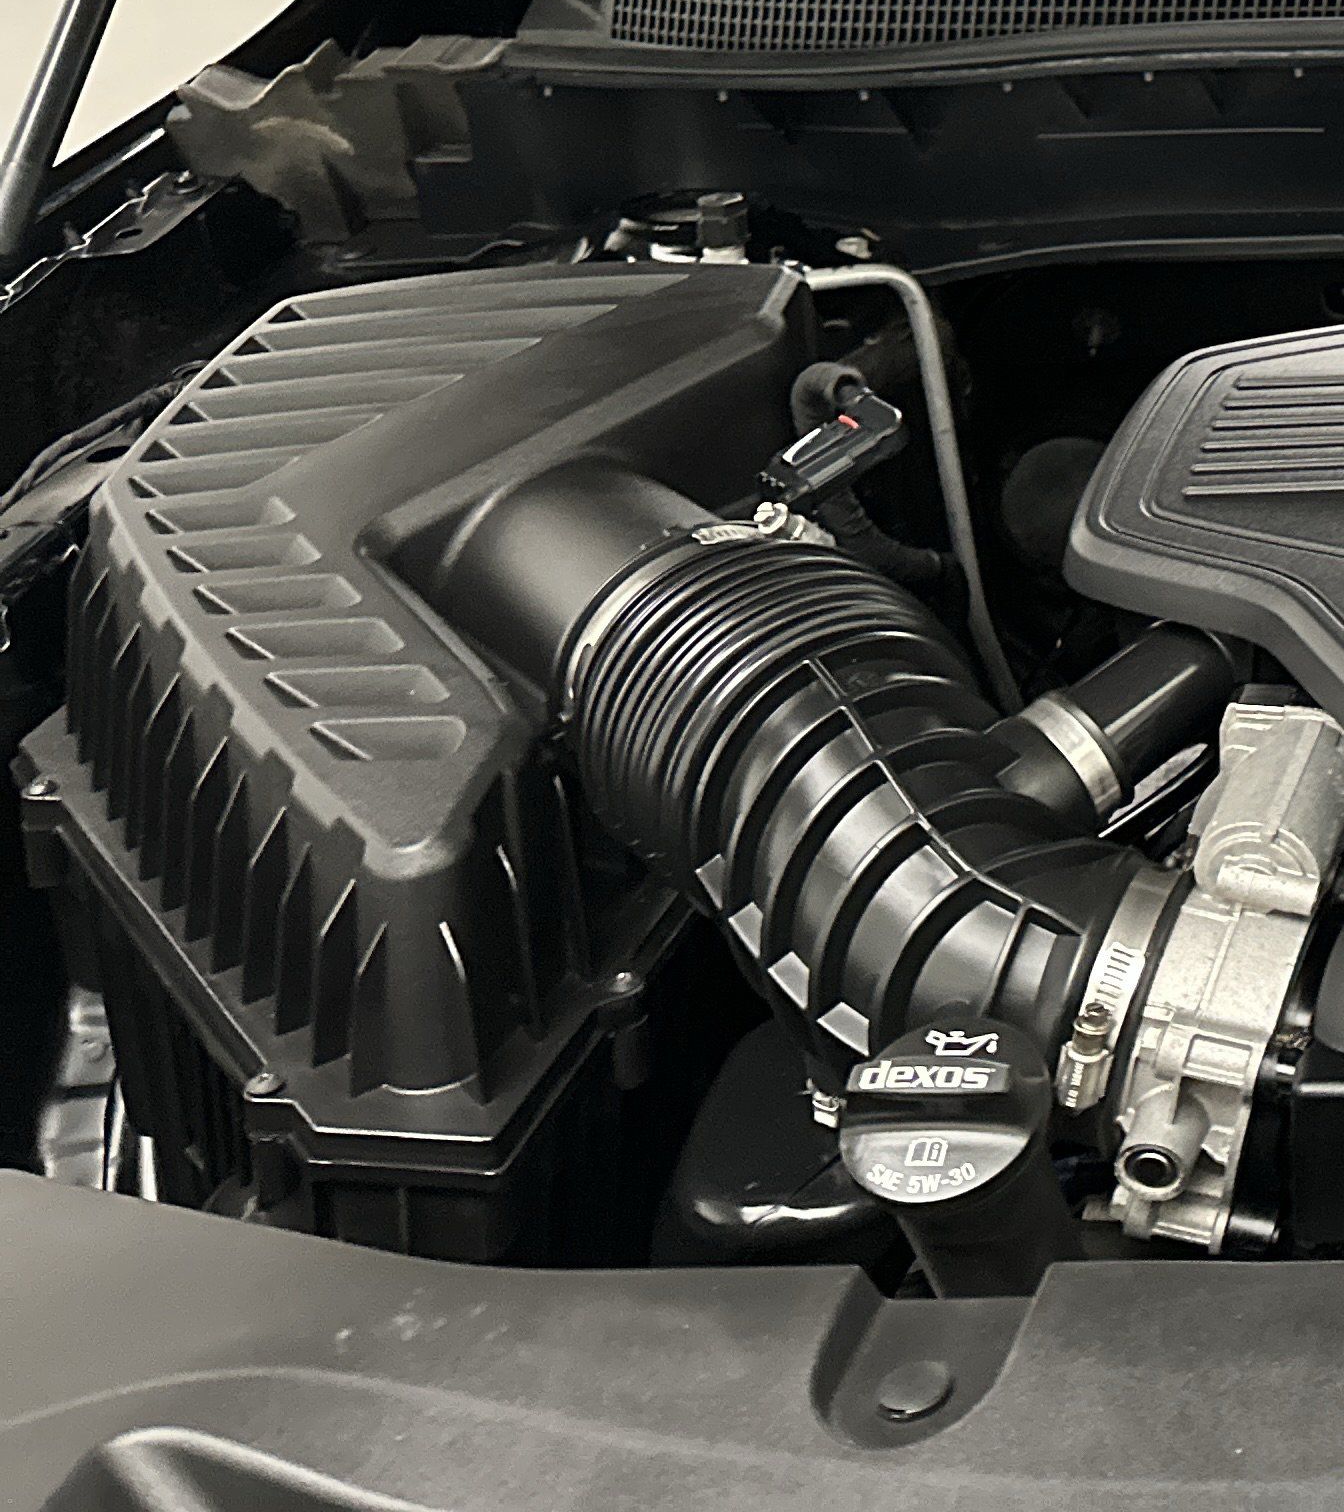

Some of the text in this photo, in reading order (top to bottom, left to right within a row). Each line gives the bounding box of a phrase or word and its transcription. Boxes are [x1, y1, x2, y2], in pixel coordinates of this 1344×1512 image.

[858, 1061, 996, 1090] dexos
[866, 1162, 976, 1193] SAE 5W-30
